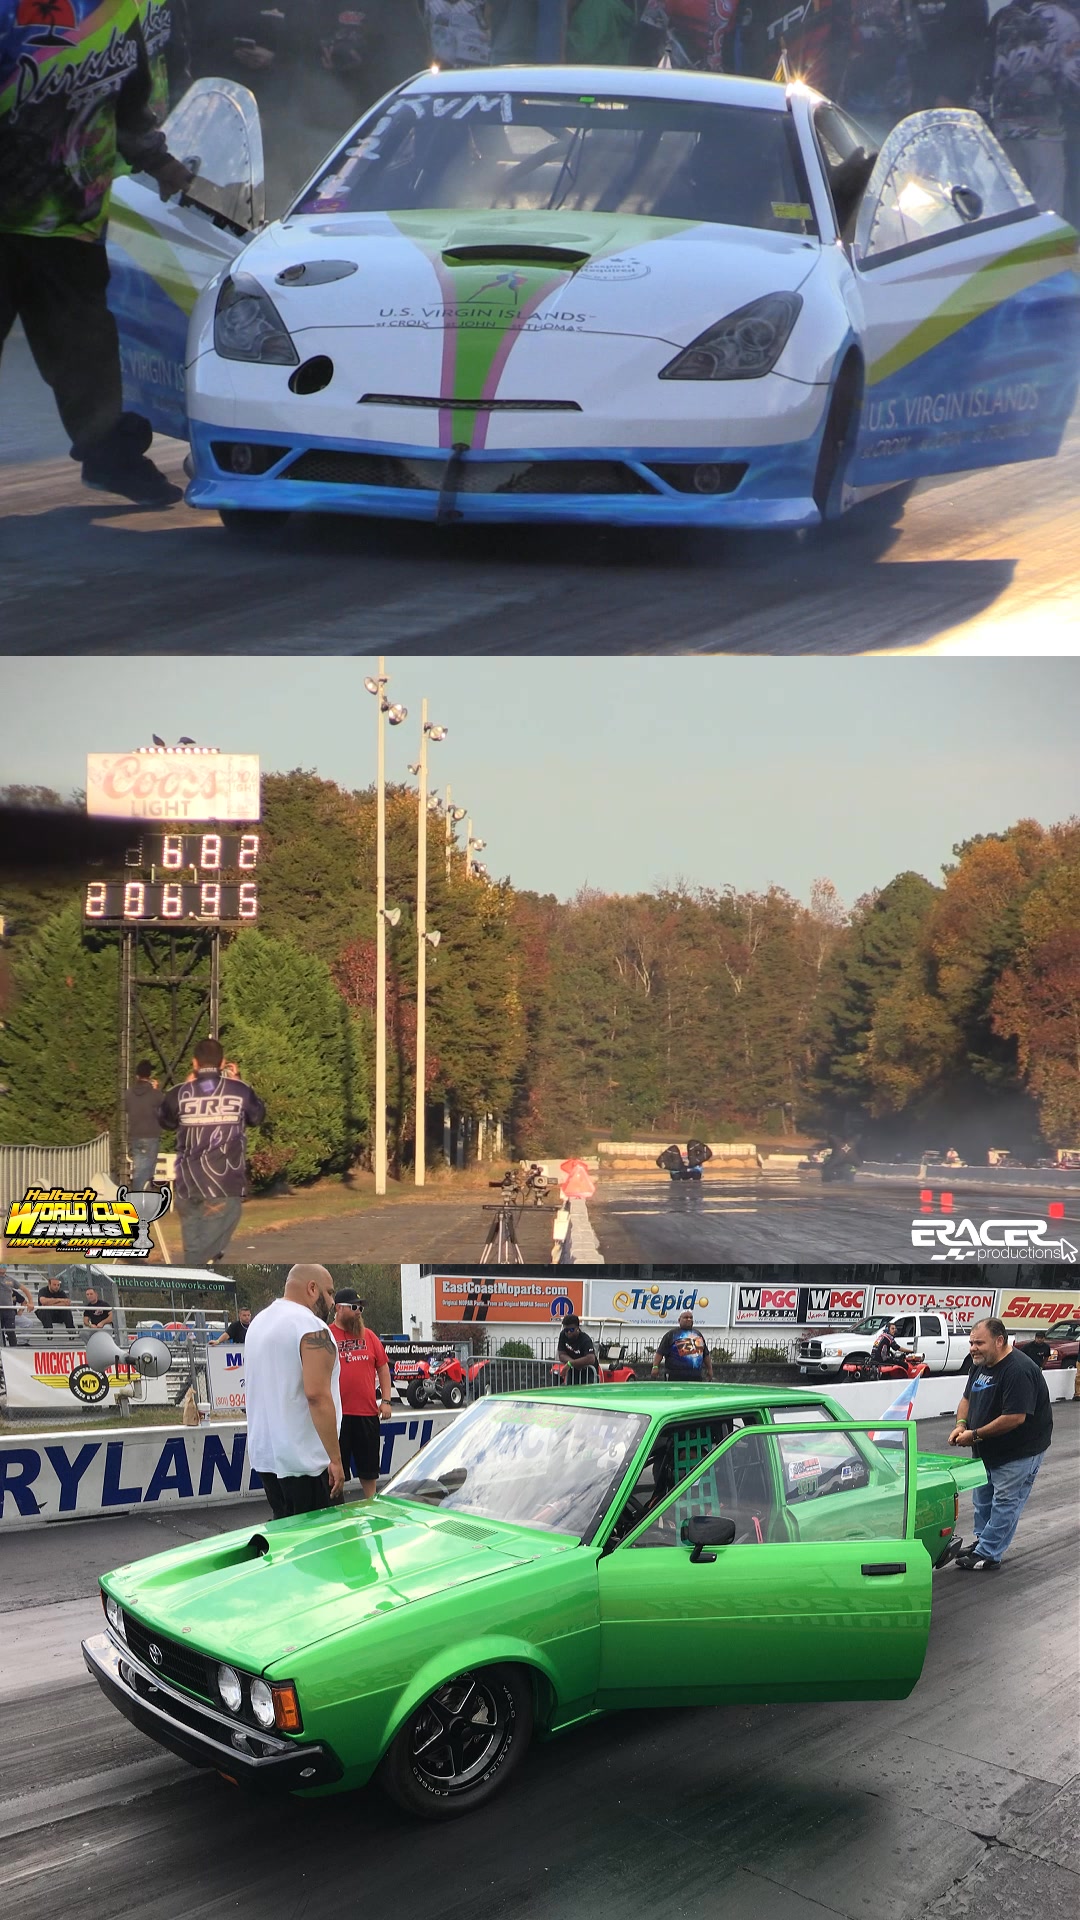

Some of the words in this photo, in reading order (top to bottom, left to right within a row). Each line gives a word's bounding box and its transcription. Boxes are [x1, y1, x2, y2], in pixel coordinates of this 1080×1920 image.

[379, 307, 414, 318] U.S.
[421, 308, 492, 318] VIRGIN
[498, 309, 586, 322] ISLANDS
[389, 320, 431, 328] CROIX
[869, 400, 898, 431] U.S.
[905, 393, 964, 424] VIRGIN
[968, 383, 1039, 417] ISLANDS
[102, 755, 217, 799] Coors
[130, 801, 192, 817] LIGHT
[113, 1277, 225, 1291] HitchcockAutoworks.com
[442, 1281, 568, 1296] EastCoastMoparts.com
[613, 1288, 698, 1316] eTrepid
[740, 1288, 797, 1308] WPGC
[811, 1289, 864, 1309] WPGC
[876, 1293, 992, 1307] TOYOTA-SCION
[385, 1345, 410, 1354] National
[34, 1352, 76, 1374] MICKEY
[82, 1379, 97, 1389] M/T
[0, 1432, 266, 1519] RYLAN
[484, 1735, 512, 1781] RACING
[413, 1767, 449, 1796] FORGED
